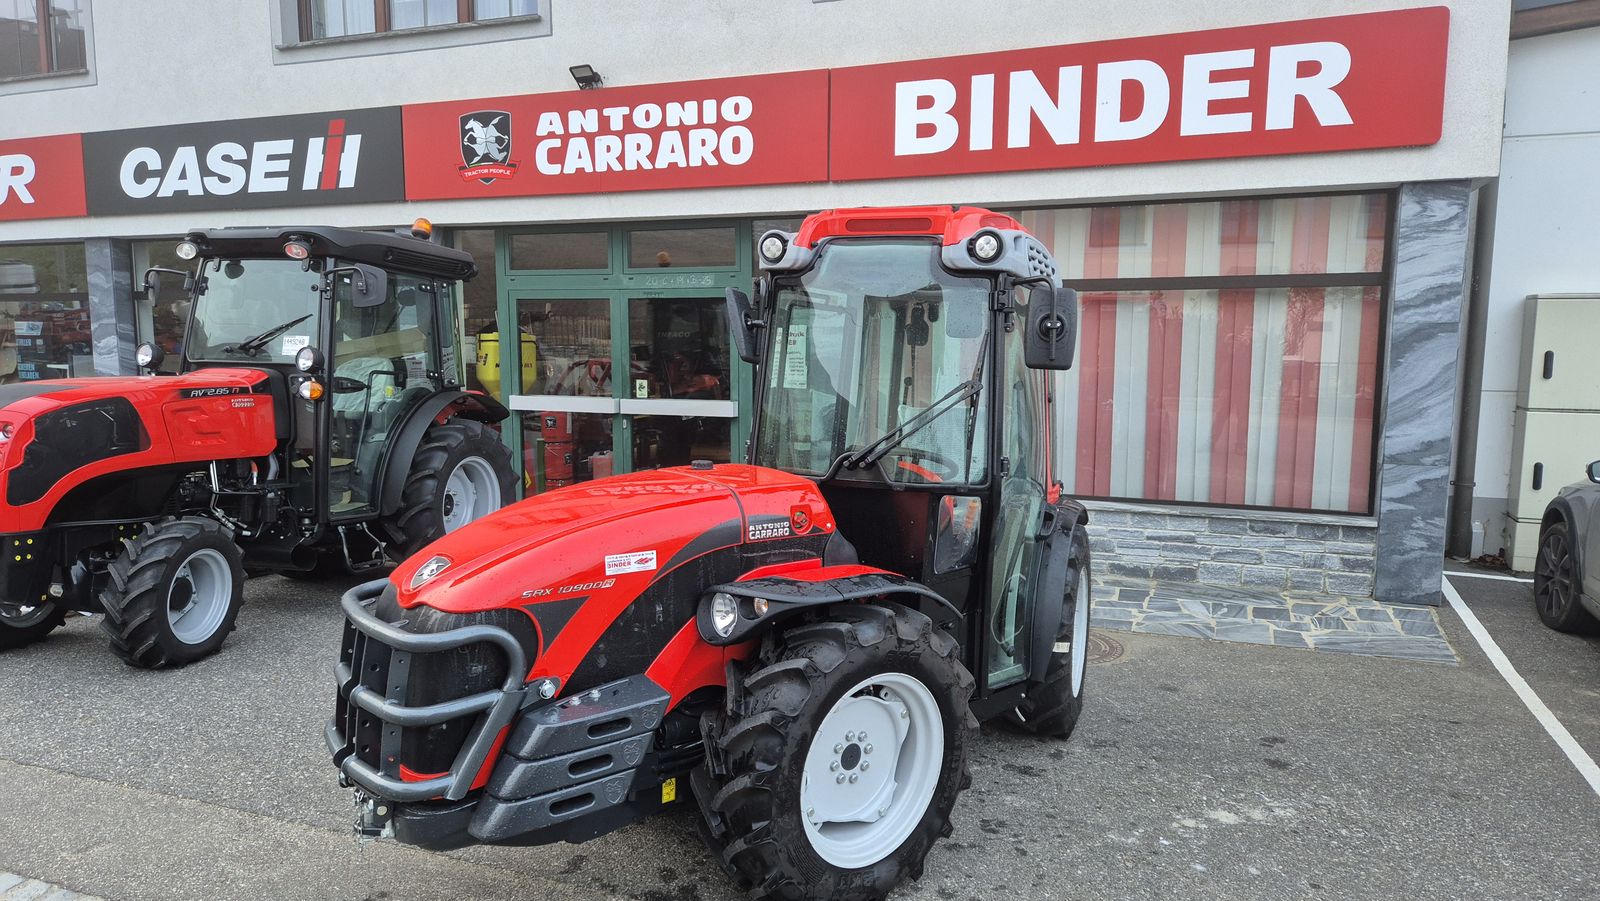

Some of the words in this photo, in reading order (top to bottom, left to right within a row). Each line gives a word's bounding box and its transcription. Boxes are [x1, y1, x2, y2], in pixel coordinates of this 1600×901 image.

[894, 40, 1353, 156] BINDER
[536, 95, 754, 137] ANTONIO
[535, 125, 754, 176] CARRARO
[119, 138, 294, 199] CASE
[464, 168, 489, 177] TRACTOR
[489, 168, 511, 176] PEOPLE
[748, 521, 790, 532] ANTONIO
[748, 528, 790, 540] CARRARO
[521, 587, 554, 599] SRX
